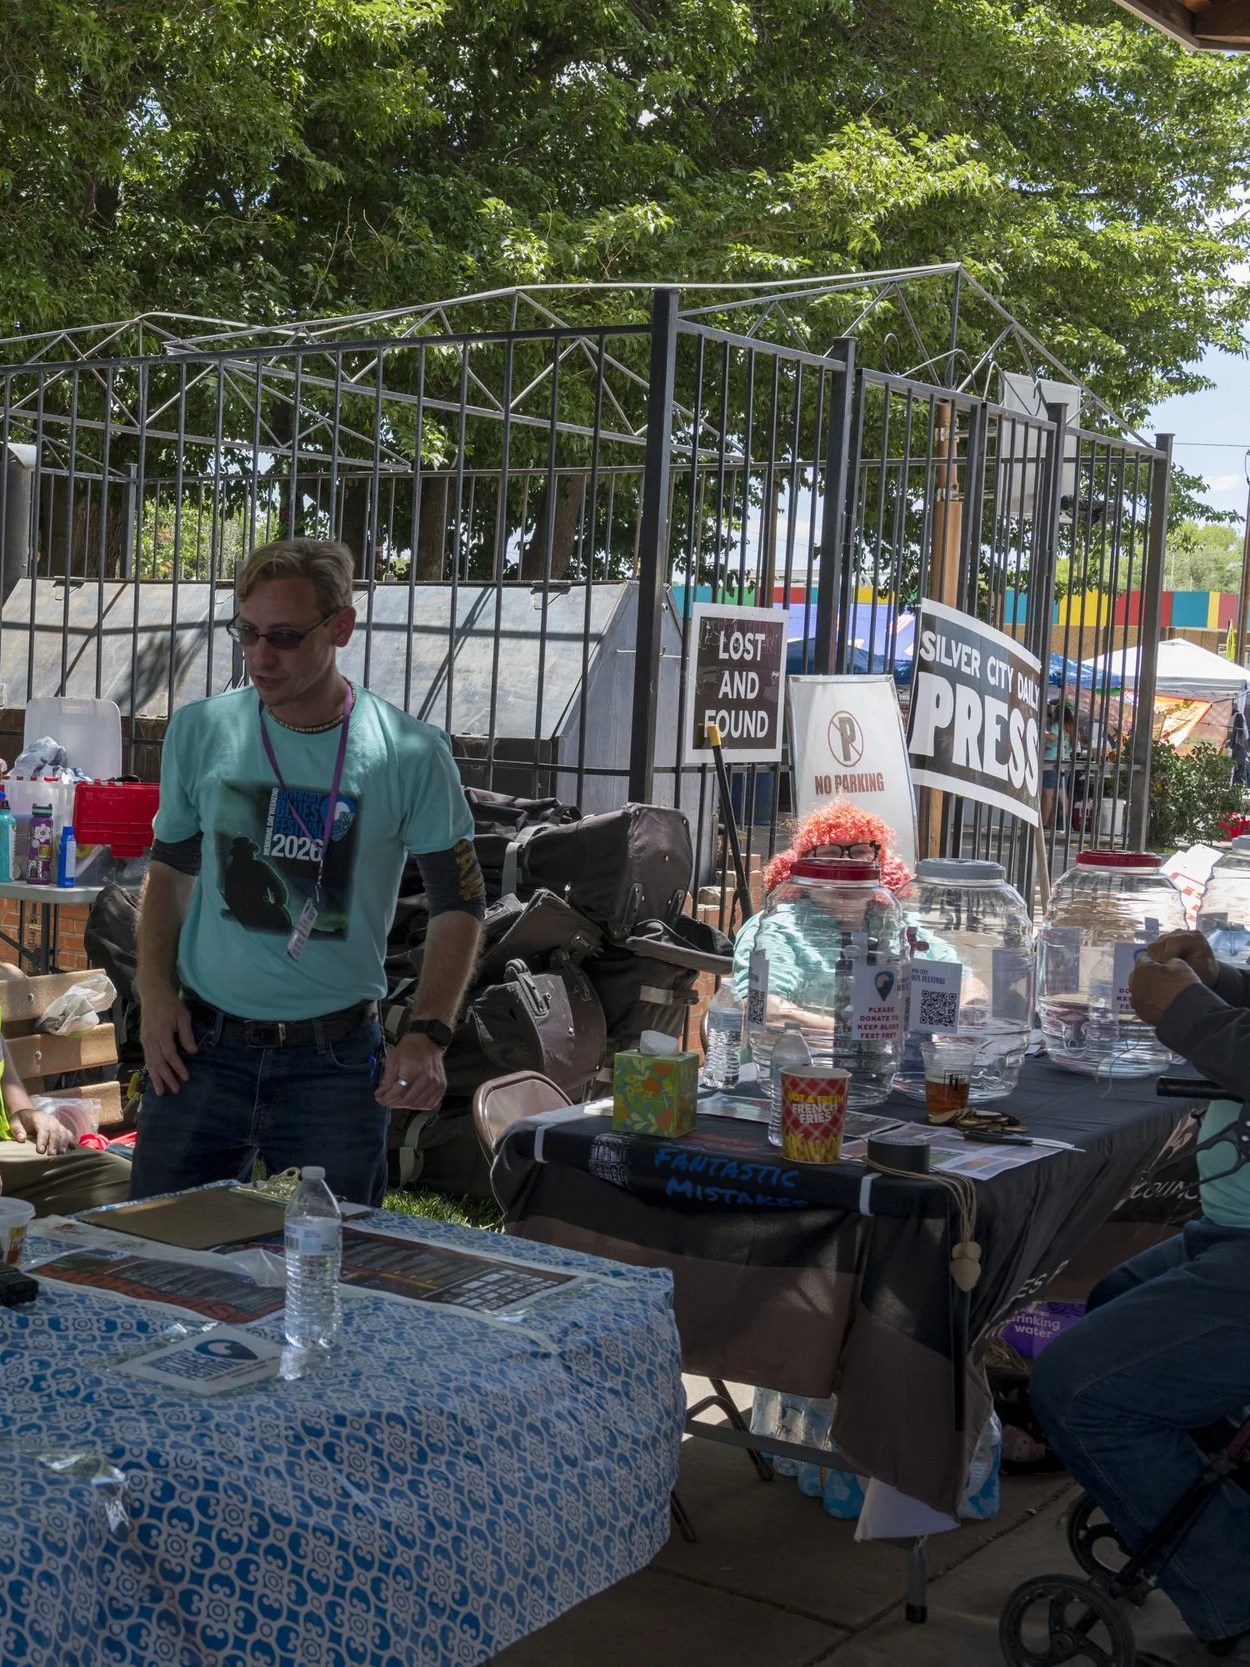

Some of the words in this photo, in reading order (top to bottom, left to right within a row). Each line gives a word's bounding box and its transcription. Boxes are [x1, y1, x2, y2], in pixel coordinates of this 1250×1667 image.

[718, 630, 766, 661] LOST
[718, 670, 759, 699] AND
[919, 630, 981, 679] SILVER
[986, 656, 1014, 693] CITY
[1018, 671, 1040, 712] DAILY
[704, 709, 769, 738] FOUND
[908, 671, 1039, 797] PRESS
[814, 775, 832, 795] NO
[835, 772, 885, 794] PARKING
[263, 826, 273, 856] MEMORIAL
[268, 787, 278, 815] WEEKEND
[271, 833, 324, 861] 2026
[788, 1091, 805, 1102] HOT
[807, 1095, 814, 1103] &
[791, 1103, 838, 1114] FRENCH
[799, 1112, 831, 1123] FRIES
[653, 1147, 799, 1188] FANTASTIC
[1014, 1325, 1053, 1339] water
[153, 1352, 215, 1374] BLUES
